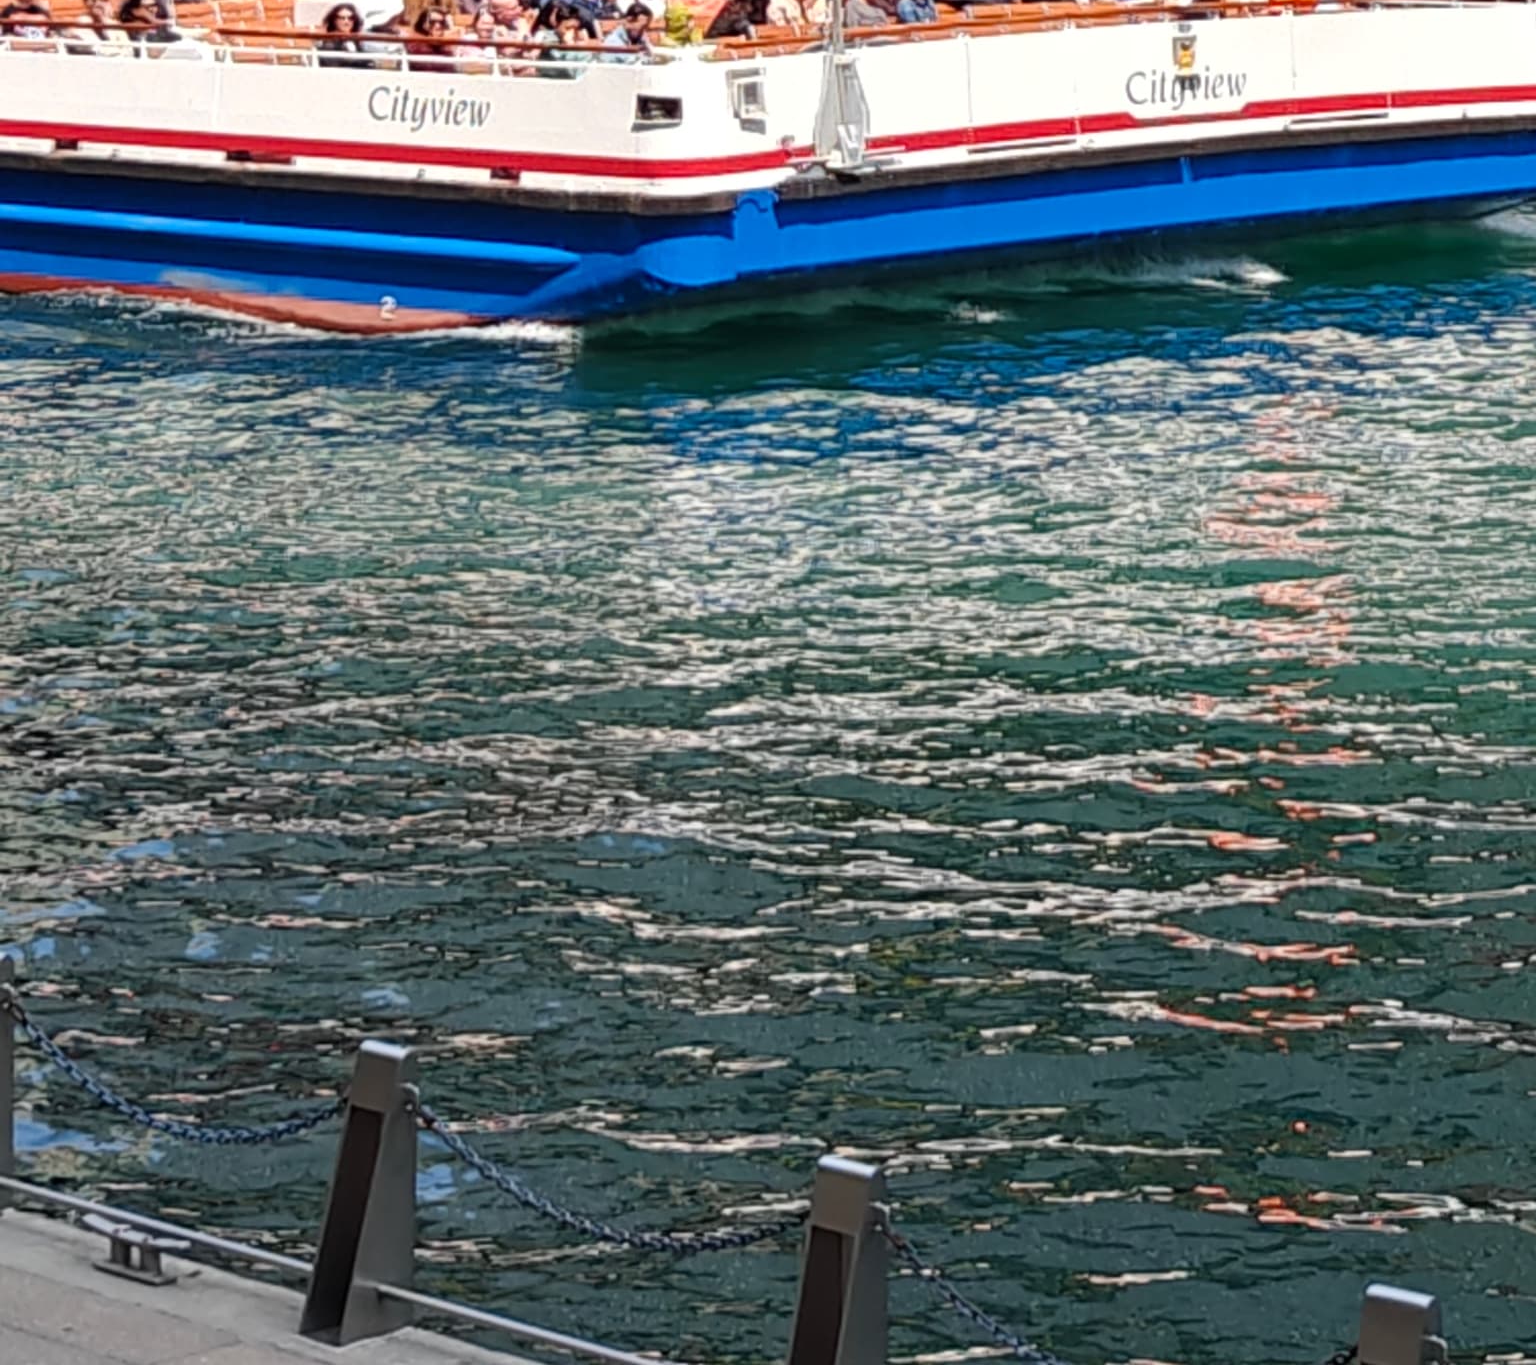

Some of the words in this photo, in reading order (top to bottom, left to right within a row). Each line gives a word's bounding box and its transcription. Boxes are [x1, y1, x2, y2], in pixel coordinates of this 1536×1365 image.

[367, 85, 491, 133] Cityview
[1125, 64, 1247, 111] Cityview
[379, 294, 398, 320] 2
